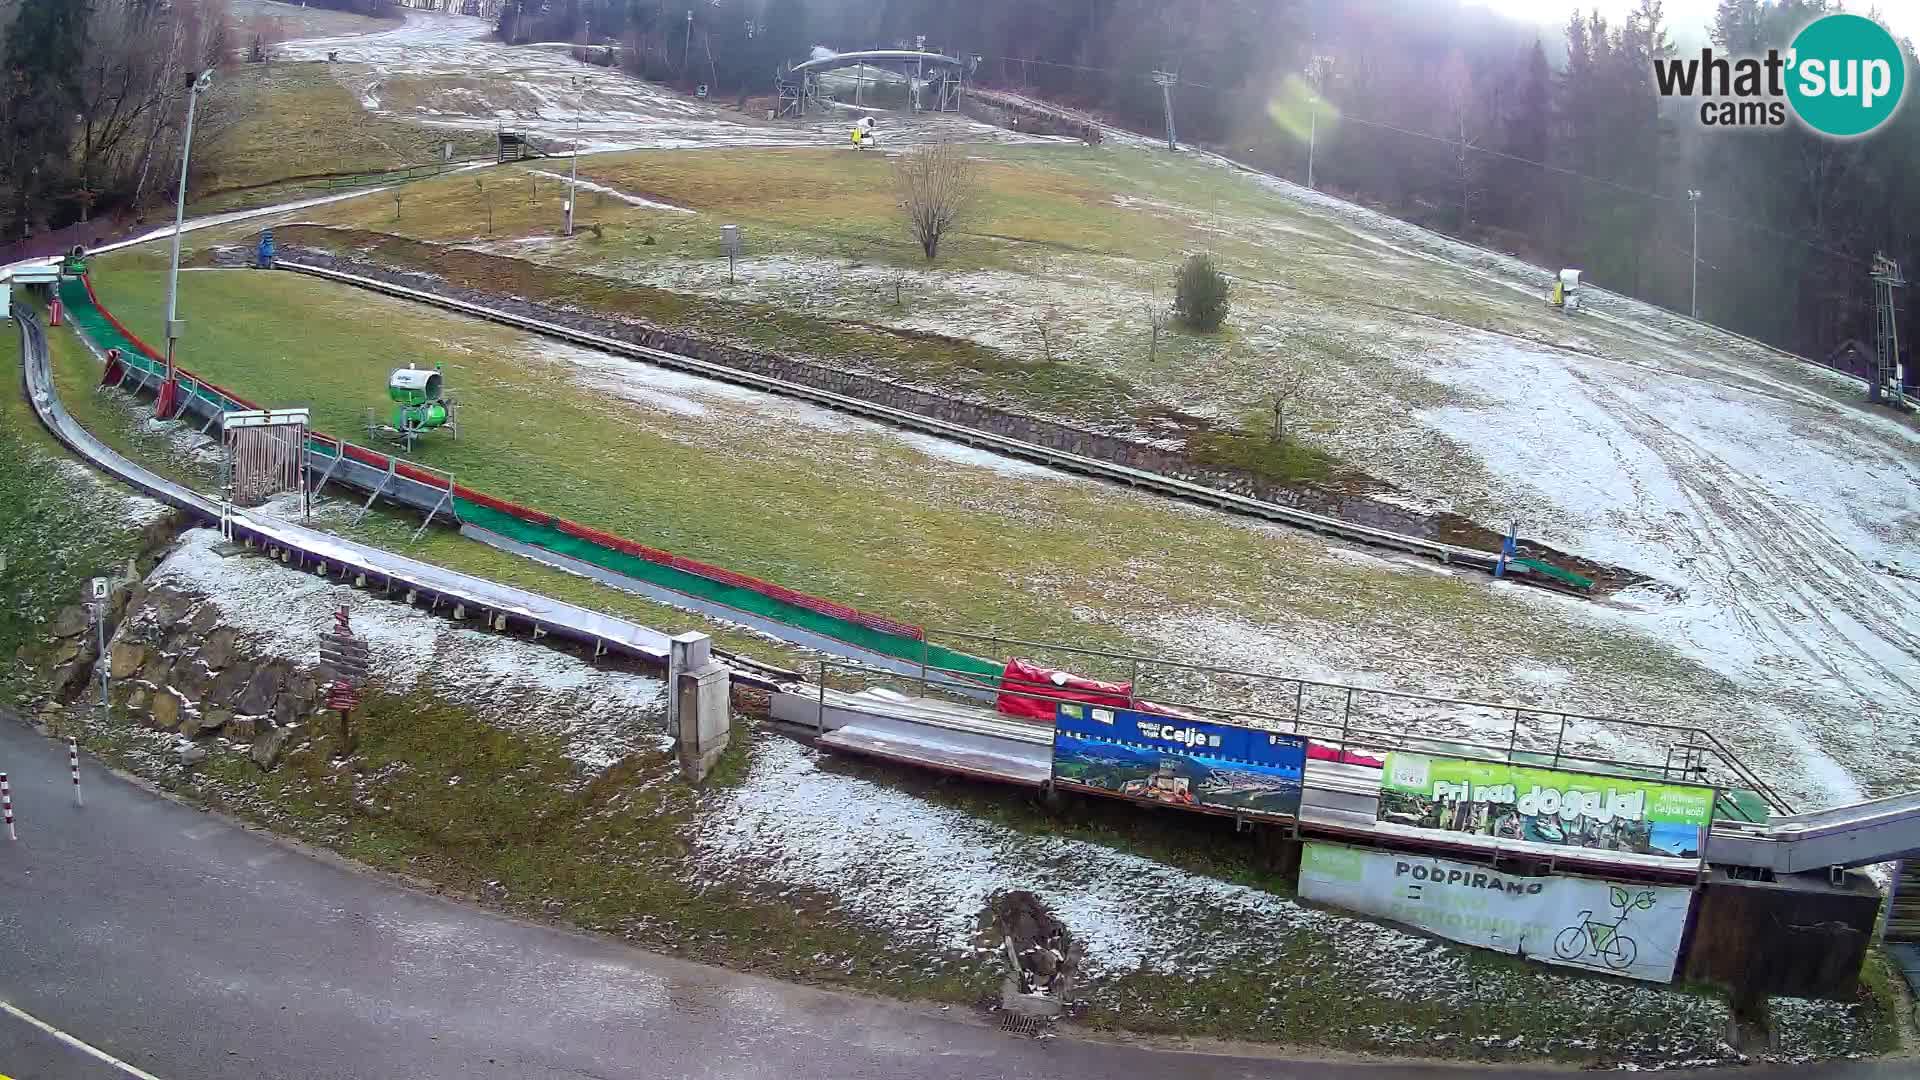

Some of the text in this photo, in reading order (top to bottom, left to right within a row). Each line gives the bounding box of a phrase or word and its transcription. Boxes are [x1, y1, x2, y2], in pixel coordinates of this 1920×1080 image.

[1161, 725, 1207, 748] Celje
[1432, 779, 1469, 803] Pri
[1473, 784, 1517, 804] nas
[1517, 784, 1646, 824] dogaja!
[1395, 861, 1544, 896] PODPIRAMO
